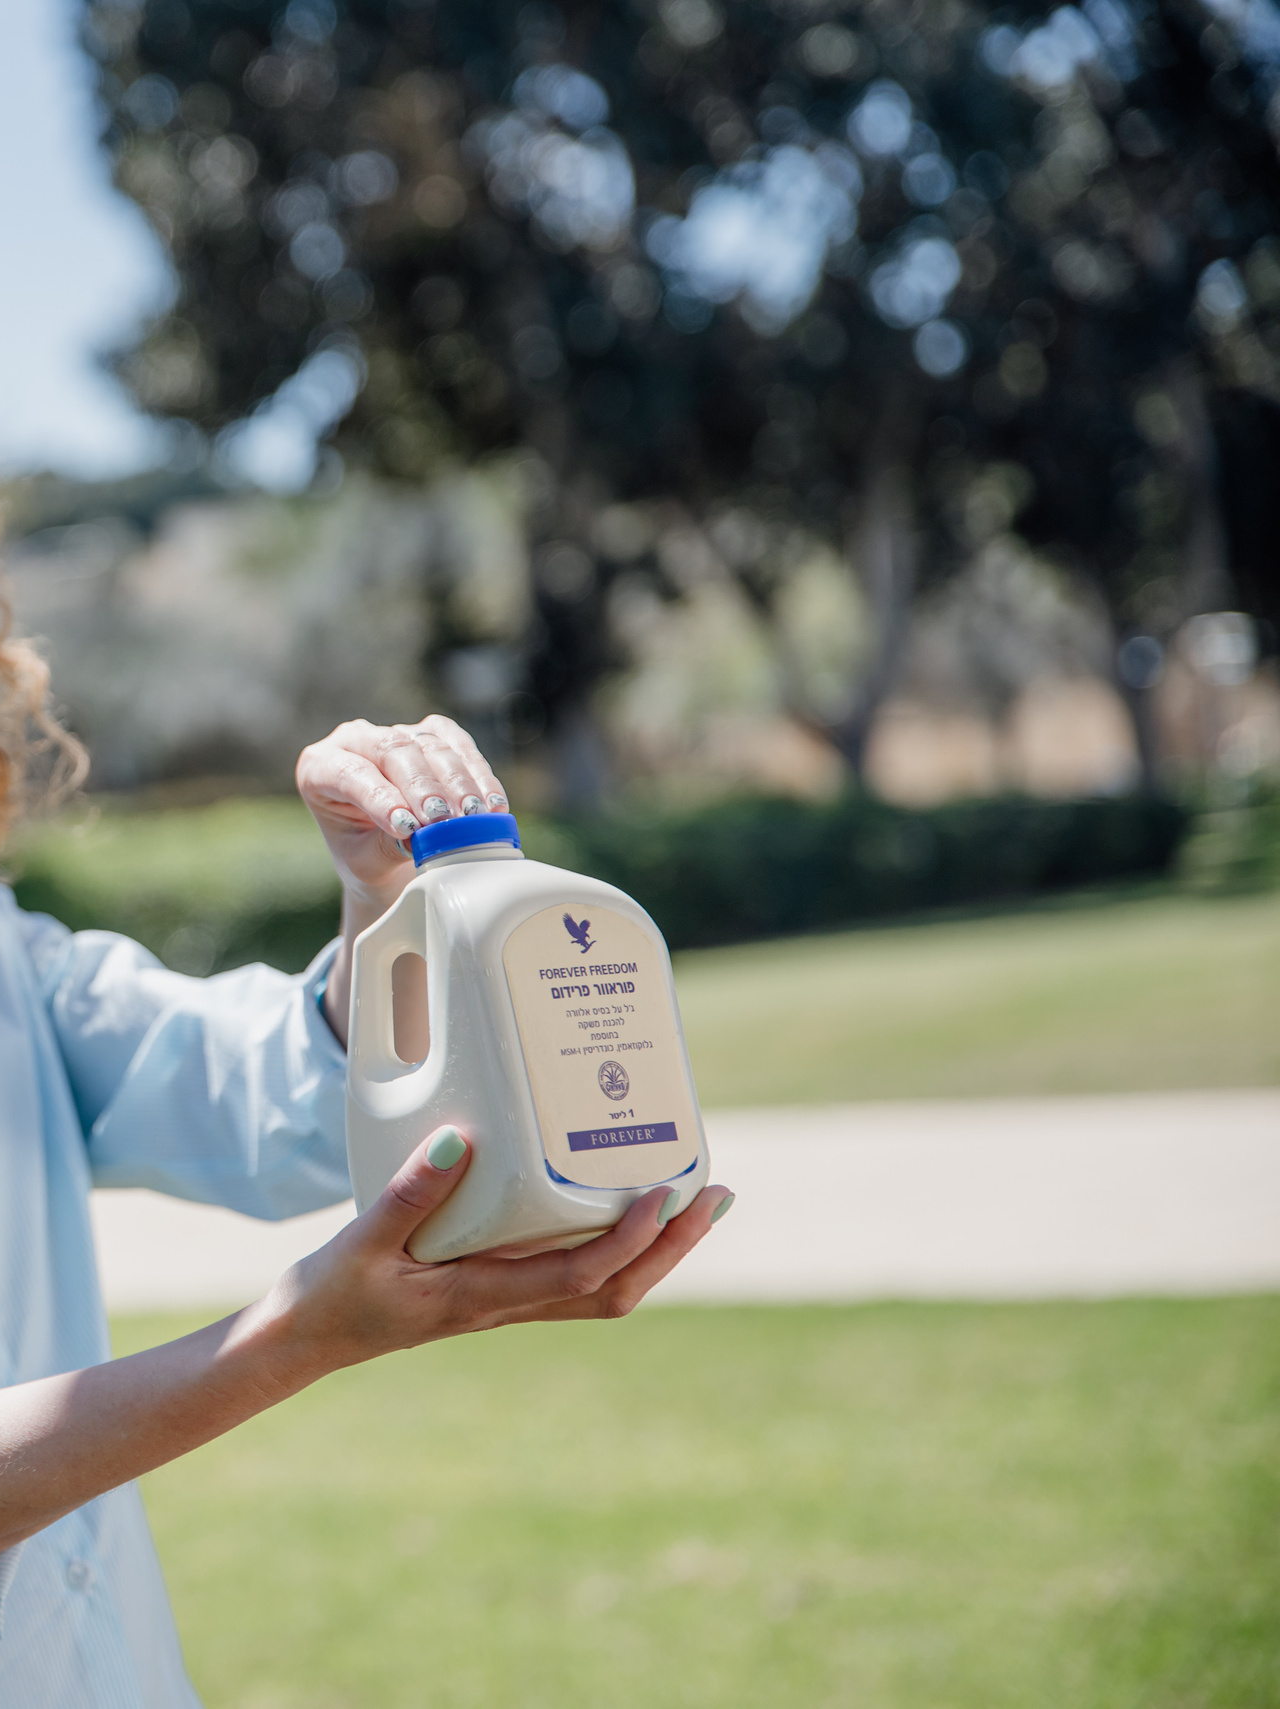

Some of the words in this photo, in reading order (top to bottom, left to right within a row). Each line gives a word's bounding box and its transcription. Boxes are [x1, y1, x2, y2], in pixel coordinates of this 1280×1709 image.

[539, 966, 588, 980] FOREVER
[589, 962, 638, 976] FREEDOM
[551, 985, 590, 1000] פרידום
[593, 981, 635, 996] פוראוור
[566, 1008, 591, 1018] אלוורה
[592, 1006, 611, 1015] בסיס
[611, 1005, 623, 1014] על
[578, 1020, 601, 1030] משקה
[602, 1017, 625, 1027] להכנת
[590, 1031, 619, 1041] בתוספת
[608, 1111, 627, 1120] ליטר
[628, 1108, 635, 1118] 1
